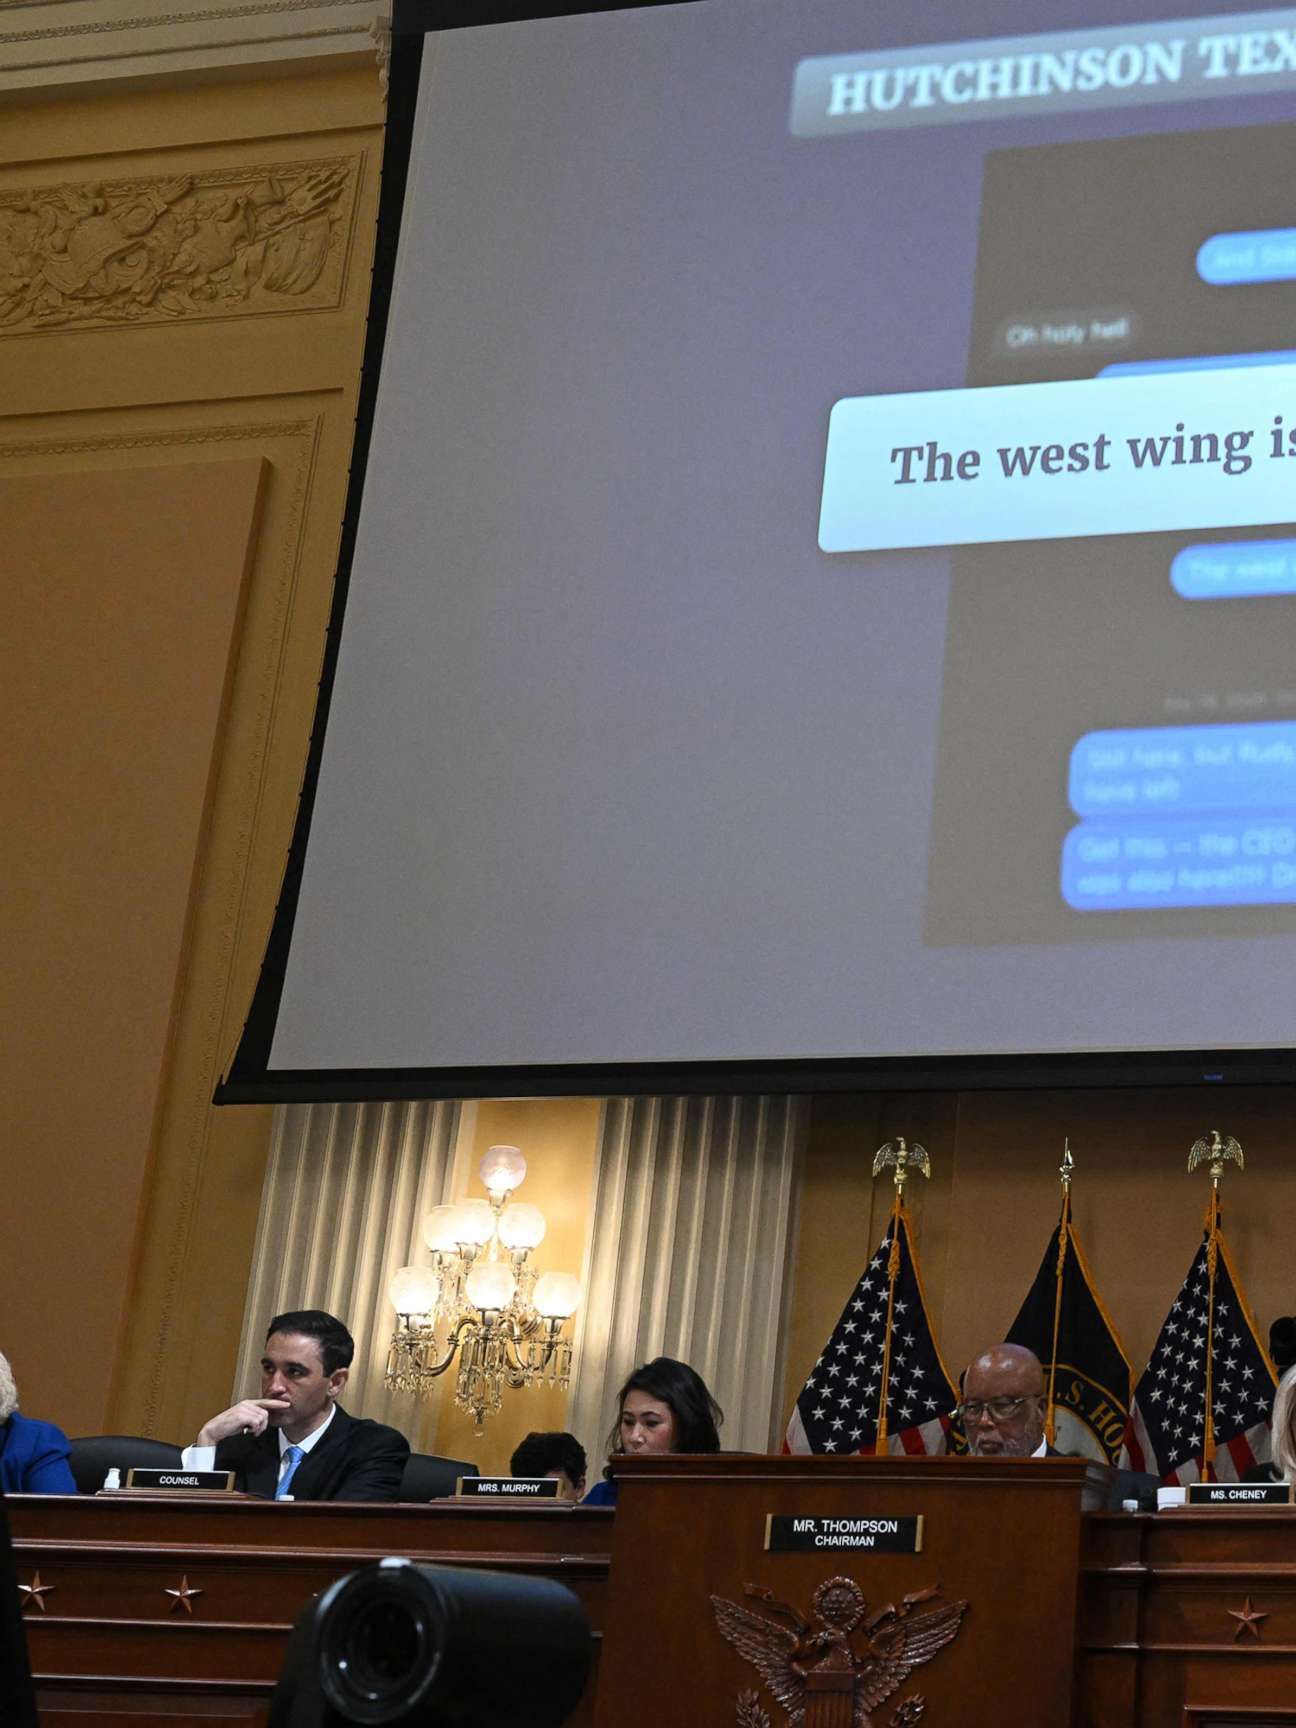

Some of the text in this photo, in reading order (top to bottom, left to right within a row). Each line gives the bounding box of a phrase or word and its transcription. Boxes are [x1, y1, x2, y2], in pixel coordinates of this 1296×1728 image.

[827, 41, 1183, 116] HUTCHINSON
[890, 441, 981, 485] The
[996, 433, 1112, 478] west
[1126, 422, 1255, 476] wing
[159, 1475, 200, 1486] COUNSEL
[477, 1483, 541, 1493] MRS. MURPHY
[1210, 1489, 1267, 1500] MS. CHENEY
[793, 1519, 898, 1533] MR. THOMPSON
[814, 1535, 875, 1547] CHAIRMAN
